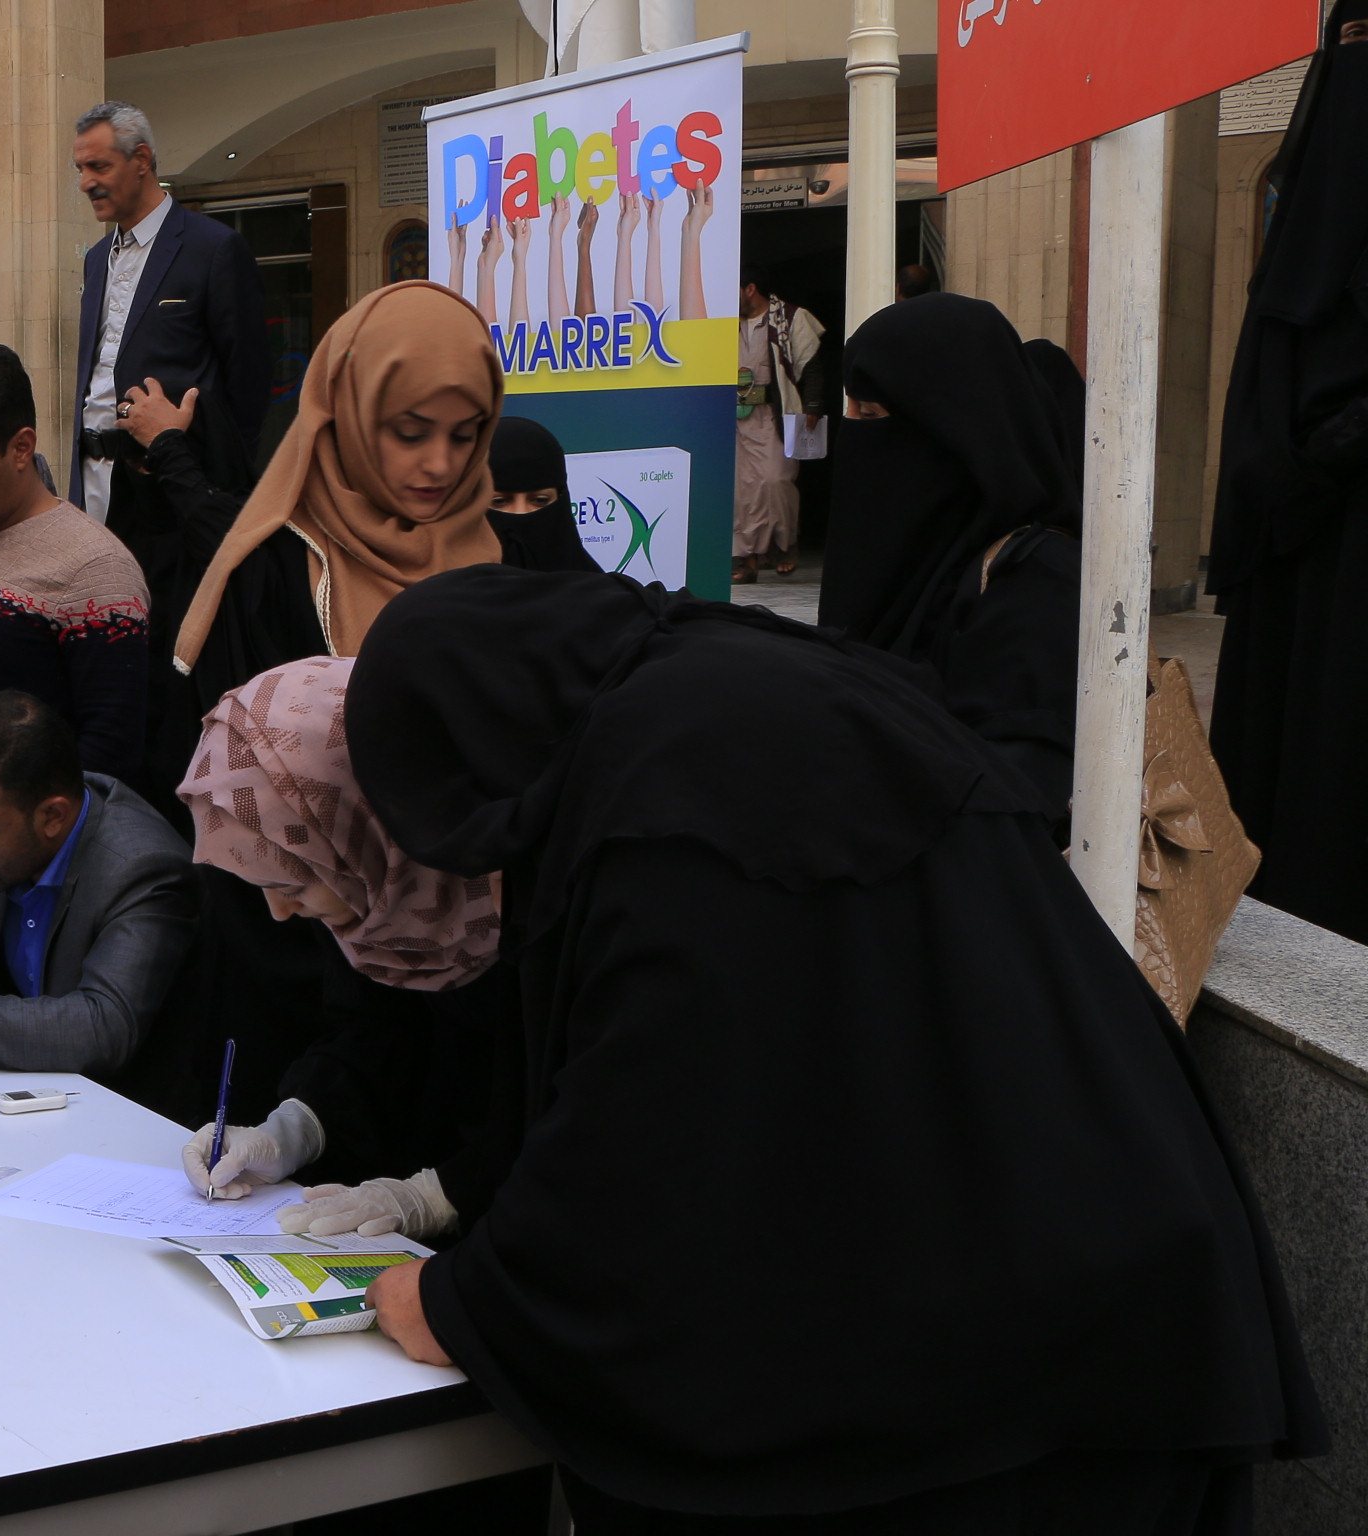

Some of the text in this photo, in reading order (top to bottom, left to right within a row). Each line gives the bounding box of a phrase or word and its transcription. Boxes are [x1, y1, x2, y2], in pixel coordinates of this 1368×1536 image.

[443, 98, 723, 231] Diabetes
[742, 183, 803, 196] مدخل خاص بالرجا
[741, 200, 799, 211] Entrance for Men
[490, 301, 680, 374] MARREX
[639, 470, 674, 483] 30 Caplets
[606, 498, 616, 522] 2
[583, 536, 600, 544] mellitus
